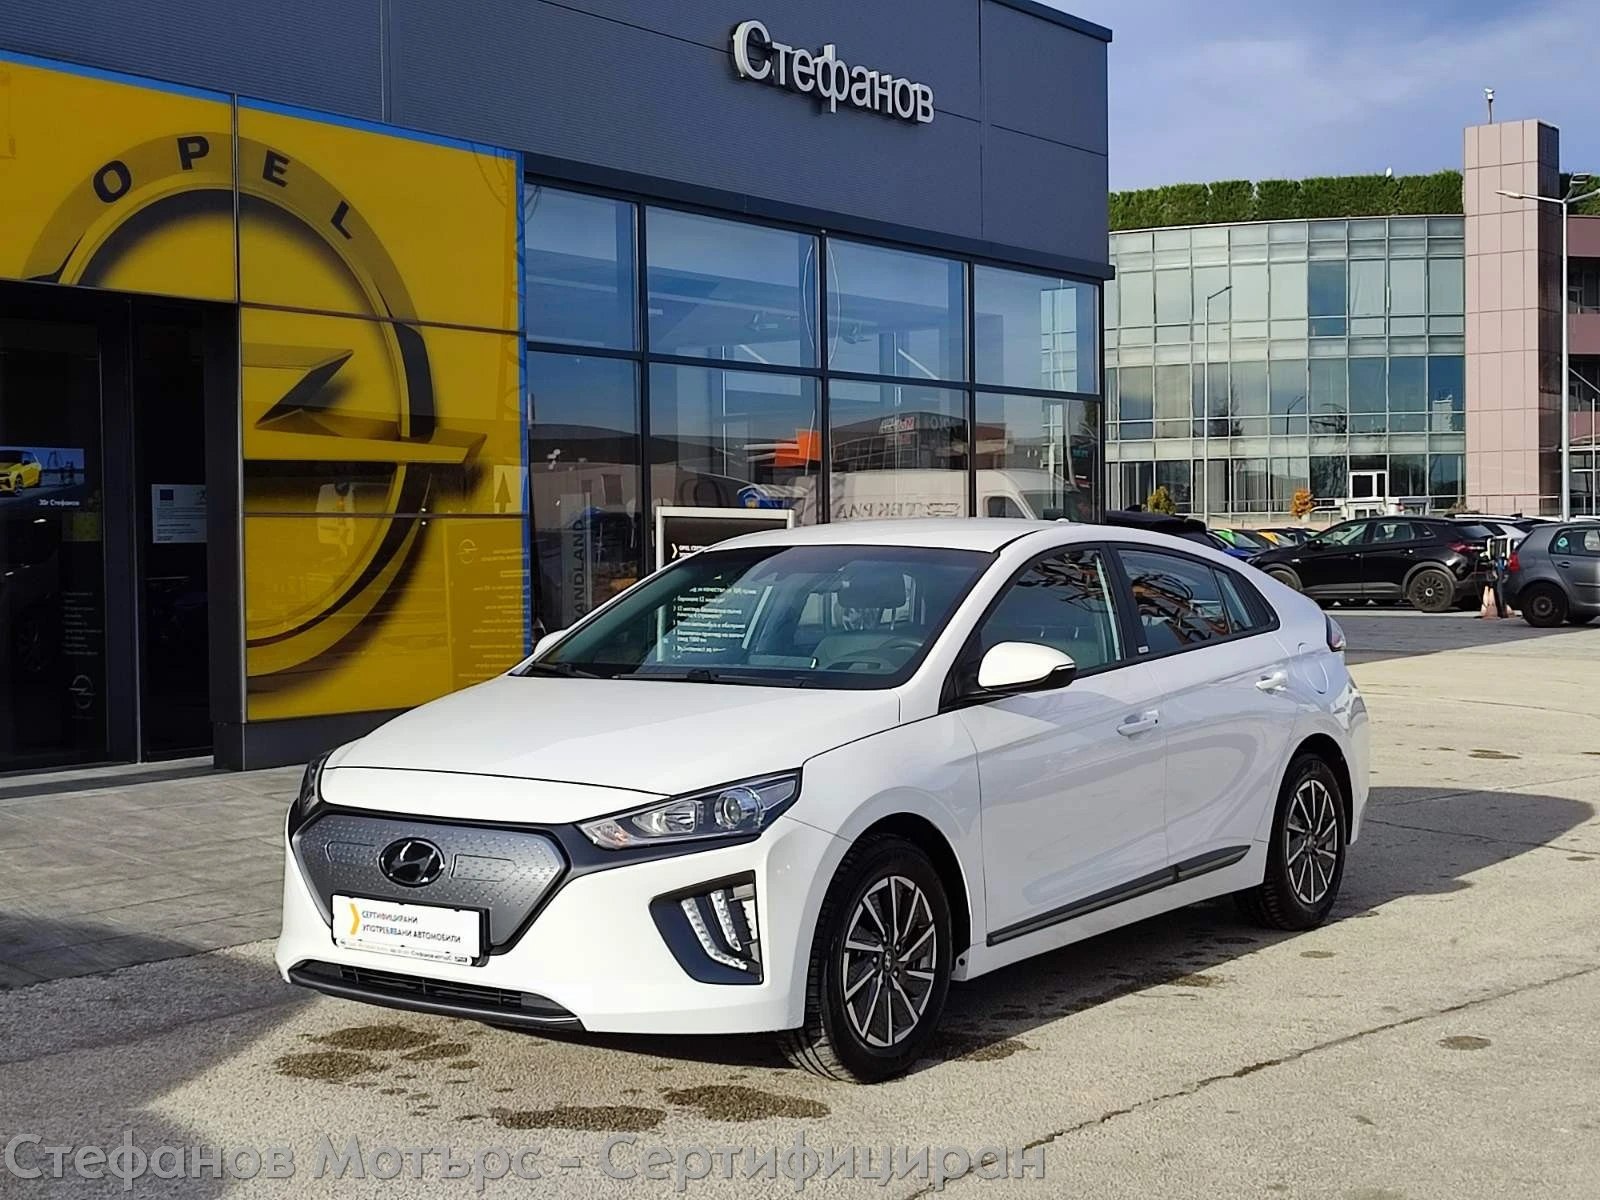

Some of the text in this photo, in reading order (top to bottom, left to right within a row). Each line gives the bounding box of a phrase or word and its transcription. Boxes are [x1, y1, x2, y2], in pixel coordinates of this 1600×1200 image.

[732, 19, 935, 123] Стефанов
[93, 135, 353, 240] OPEL
[361, 911, 418, 924] СЕРТИФИЦИРАНИ
[413, 931, 462, 944] АВТОМОБИЛИ
